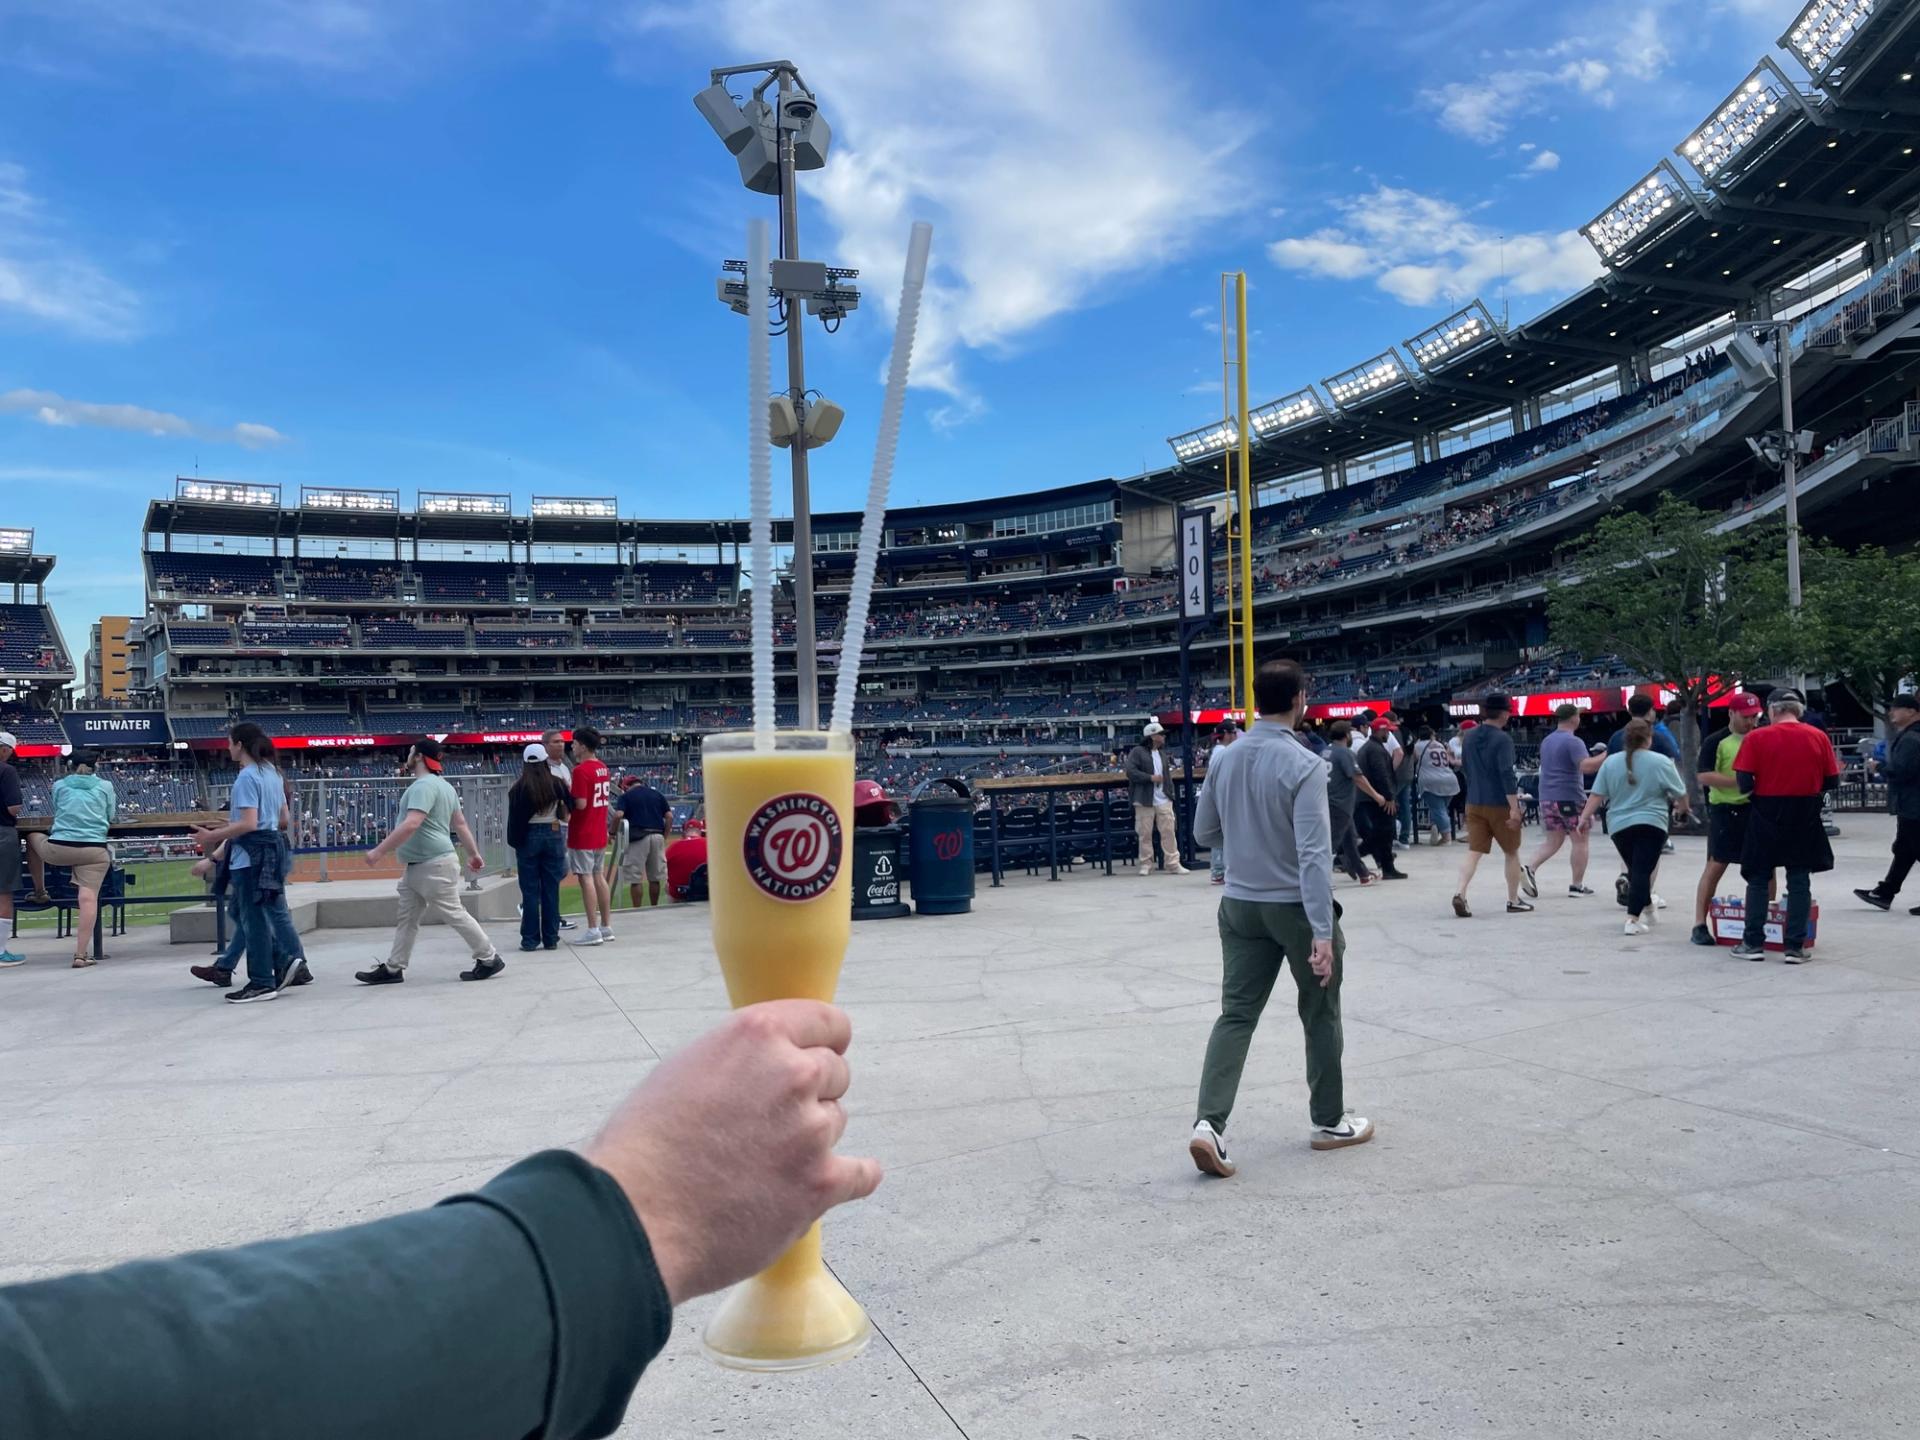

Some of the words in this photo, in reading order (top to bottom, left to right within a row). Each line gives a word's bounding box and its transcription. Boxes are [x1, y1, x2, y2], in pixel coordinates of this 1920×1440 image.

[1188, 525, 1201, 606] 104
[85, 719, 151, 731] CUTWATER
[593, 781, 609, 807] 29
[749, 798, 840, 837] WASHINGTON
[753, 863, 837, 897] NATIONALS
